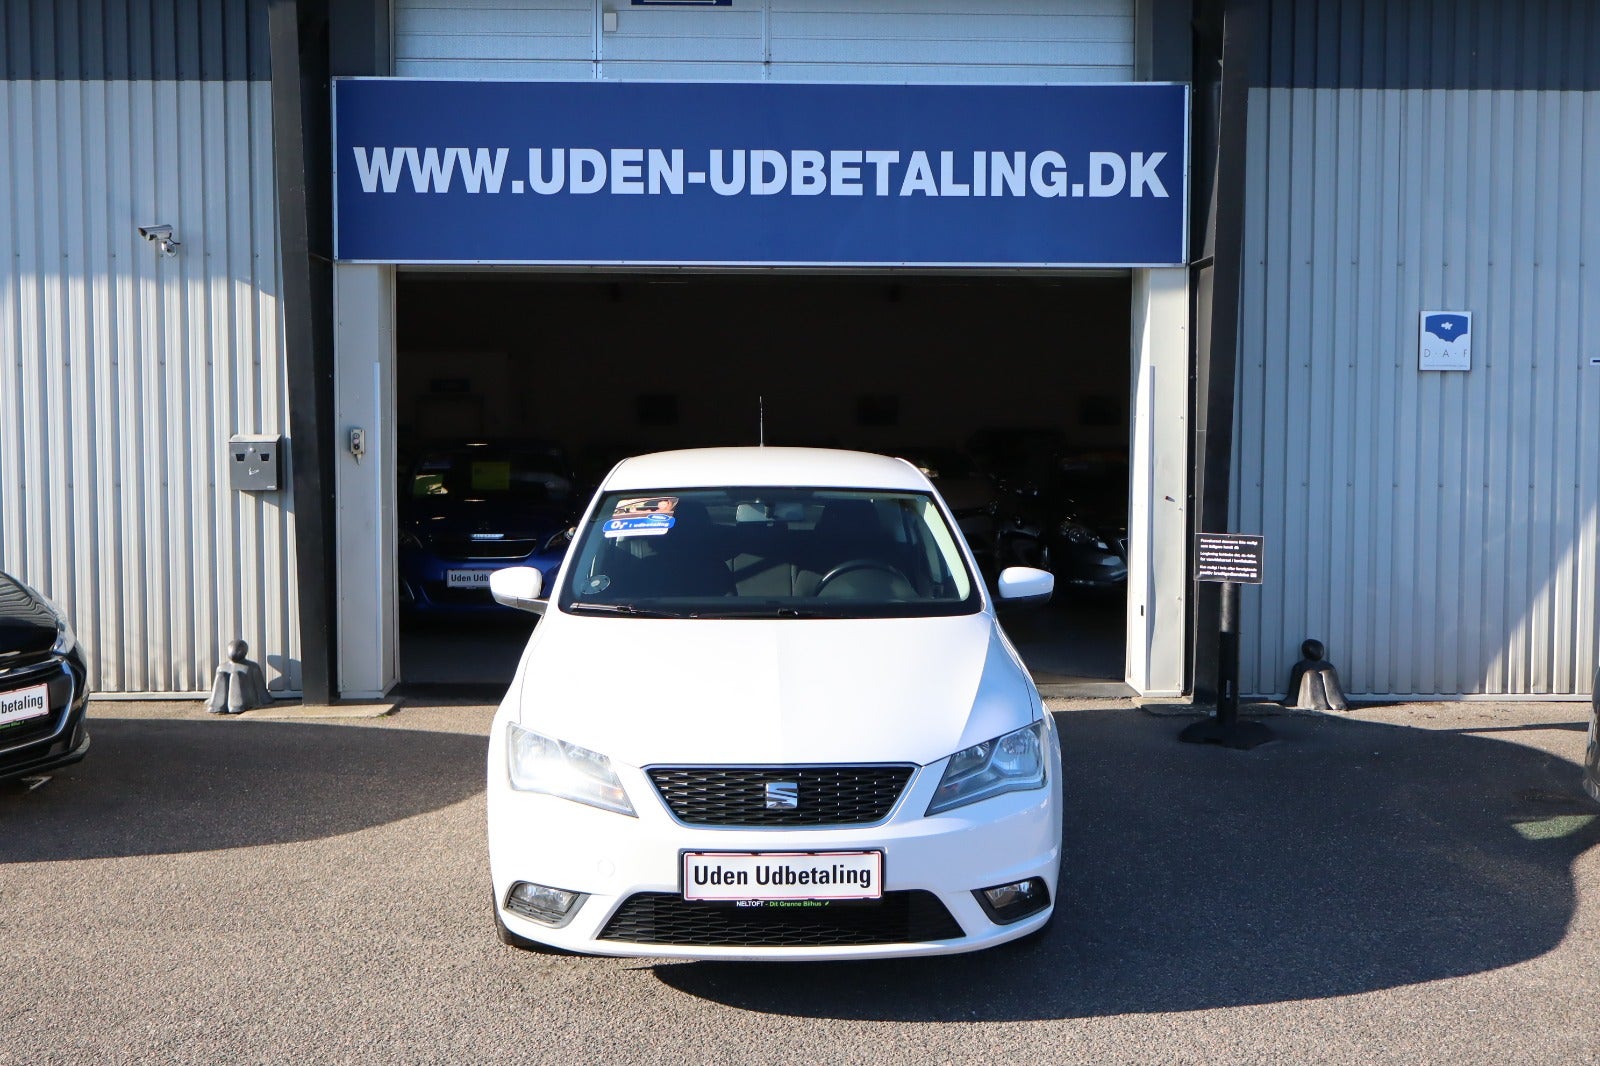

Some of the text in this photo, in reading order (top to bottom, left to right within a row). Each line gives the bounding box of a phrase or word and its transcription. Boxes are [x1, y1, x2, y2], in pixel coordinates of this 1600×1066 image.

[352, 146, 1170, 198] WWW.UDEN-UDBETALING.DK
[451, 574, 472, 582] Uden
[694, 864, 872, 888] Uden Udbetaling
